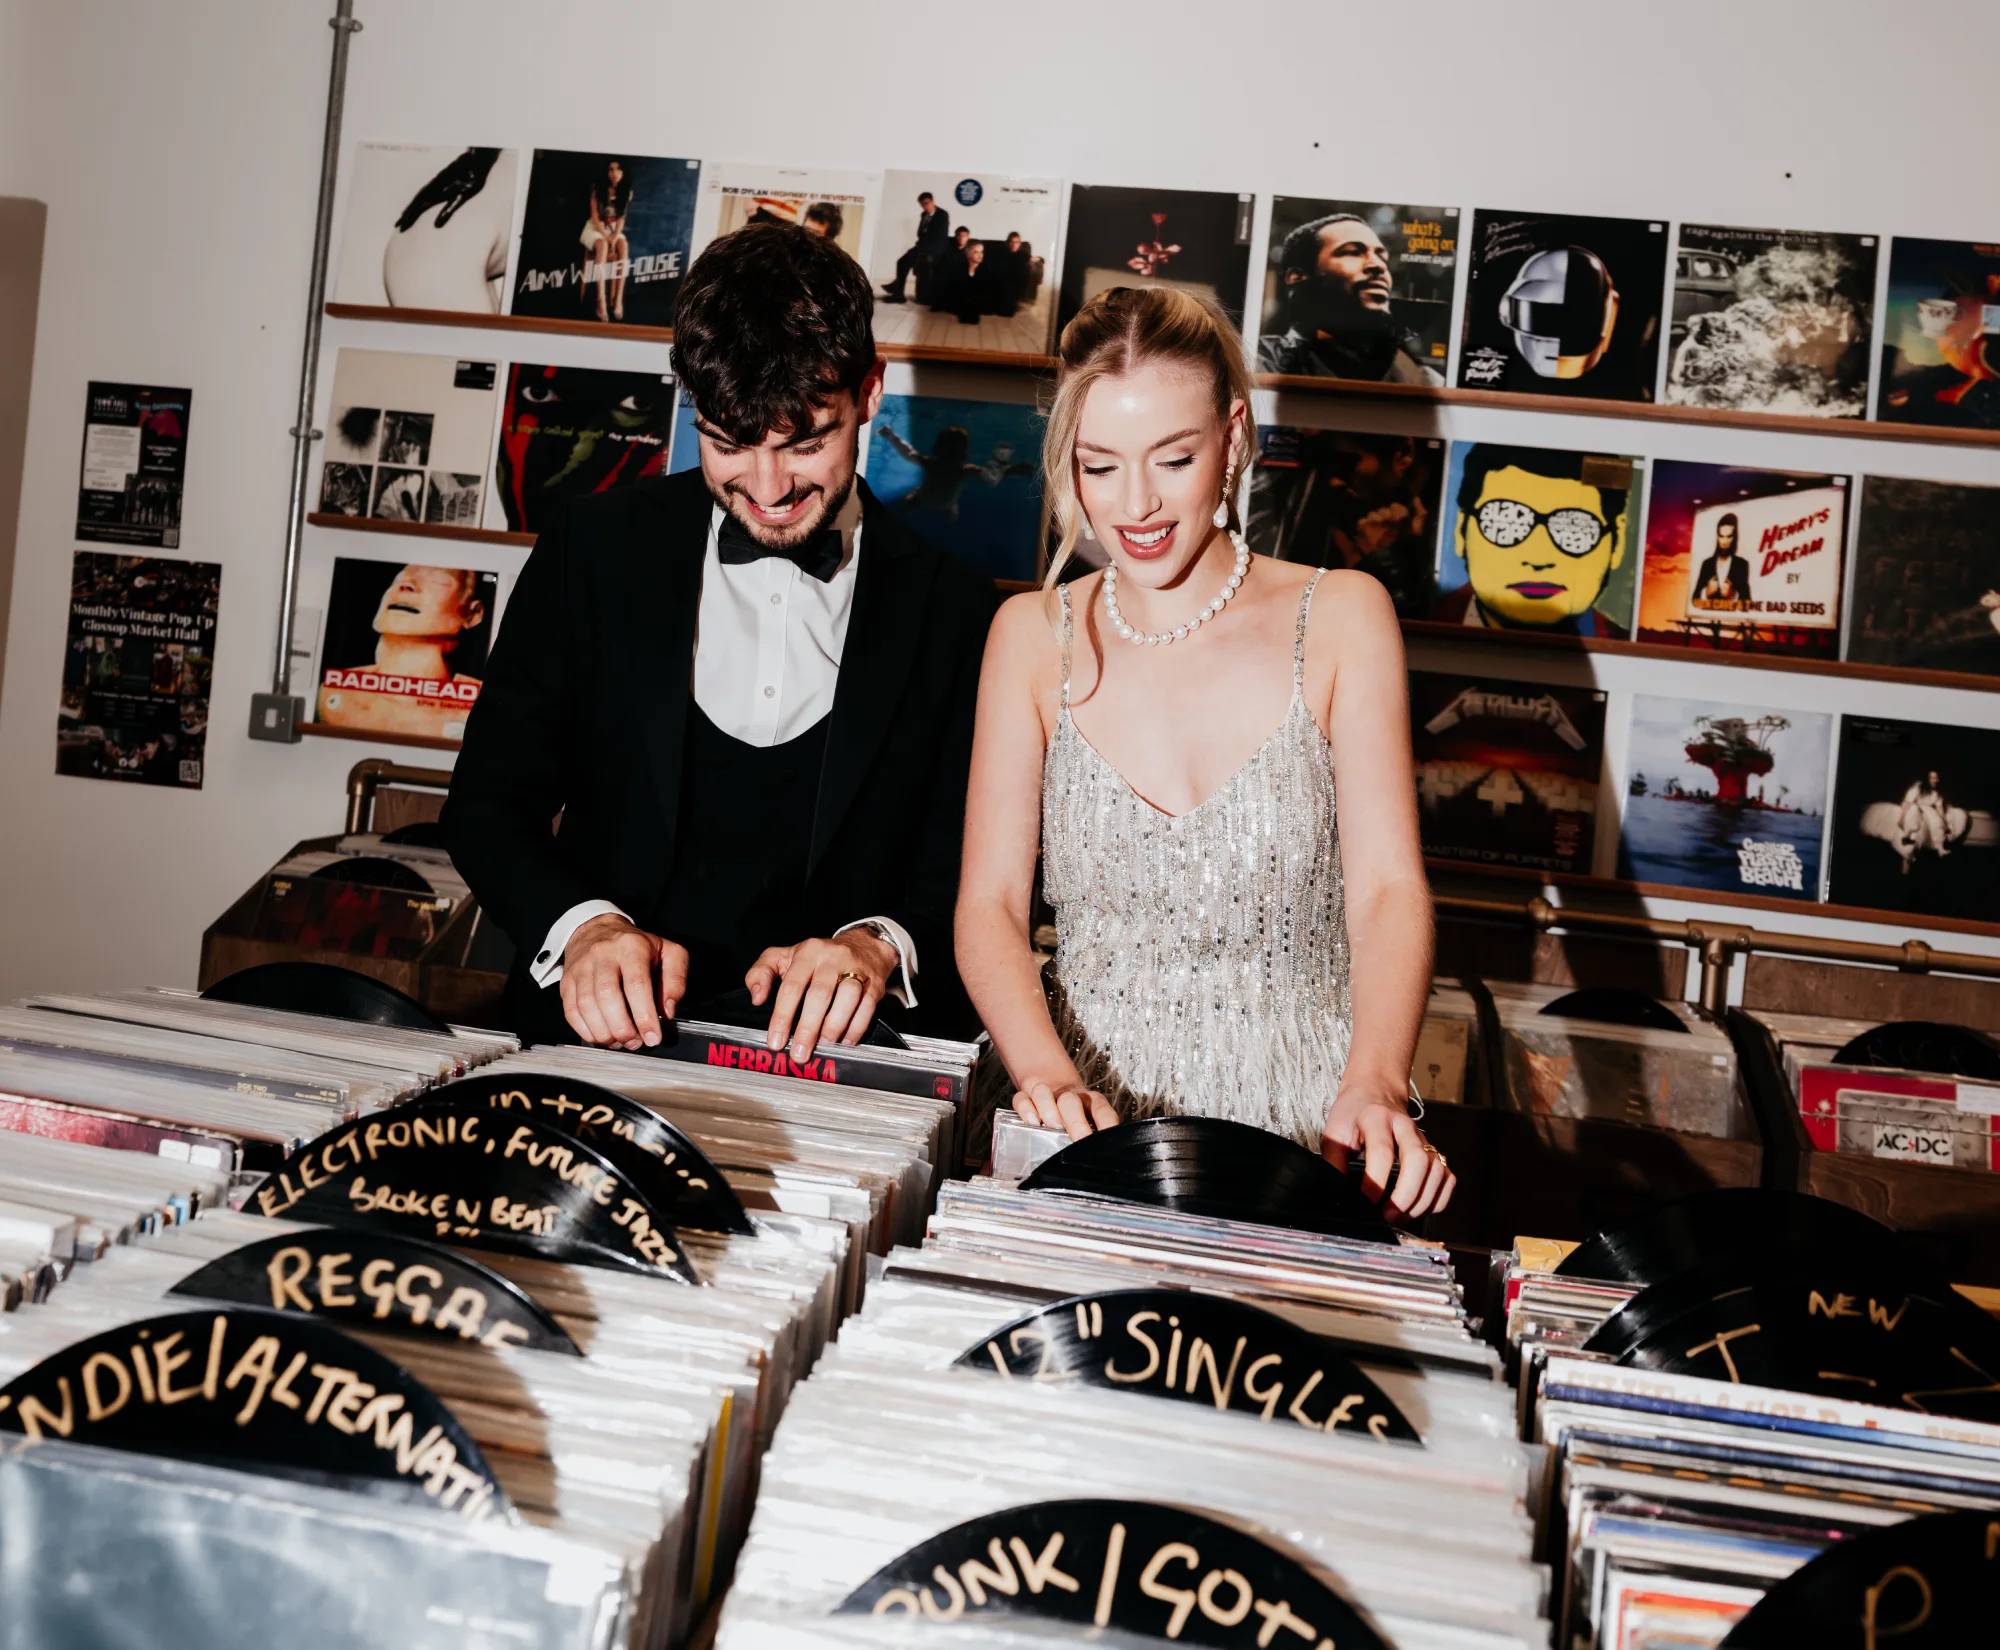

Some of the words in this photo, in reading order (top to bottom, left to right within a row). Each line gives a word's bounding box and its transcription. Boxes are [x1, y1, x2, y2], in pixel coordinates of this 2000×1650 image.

[722, 186, 739, 195] BOB
[741, 188, 768, 197] DYLAN
[1407, 237, 1440, 255] going
[519, 268, 567, 294] AMY
[570, 251, 682, 285] WINEHOUSE
[1759, 508, 1830, 553] HENRY'S
[1760, 537, 1824, 577] DREAM
[1787, 573, 1801, 585] BY
[71, 603, 118, 619] Monthly
[120, 607, 167, 623] Vintage
[1766, 601, 1787, 612] BAD
[1790, 602, 1825, 615] SEEDS
[81, 618, 129, 636] Glossop
[130, 623, 173, 639] Market
[174, 628, 200, 642] Hall
[325, 669, 479, 702] RADIOHEAD
[253, 1084, 267, 1093] TWO
[258, 1116, 495, 1218] ELECTRONIC,
[504, 1126, 618, 1206] FUTURE
[611, 1198, 679, 1269] JAZZ
[349, 1176, 482, 1225] BROKEN
[1808, 1289, 1911, 1331] NEW
